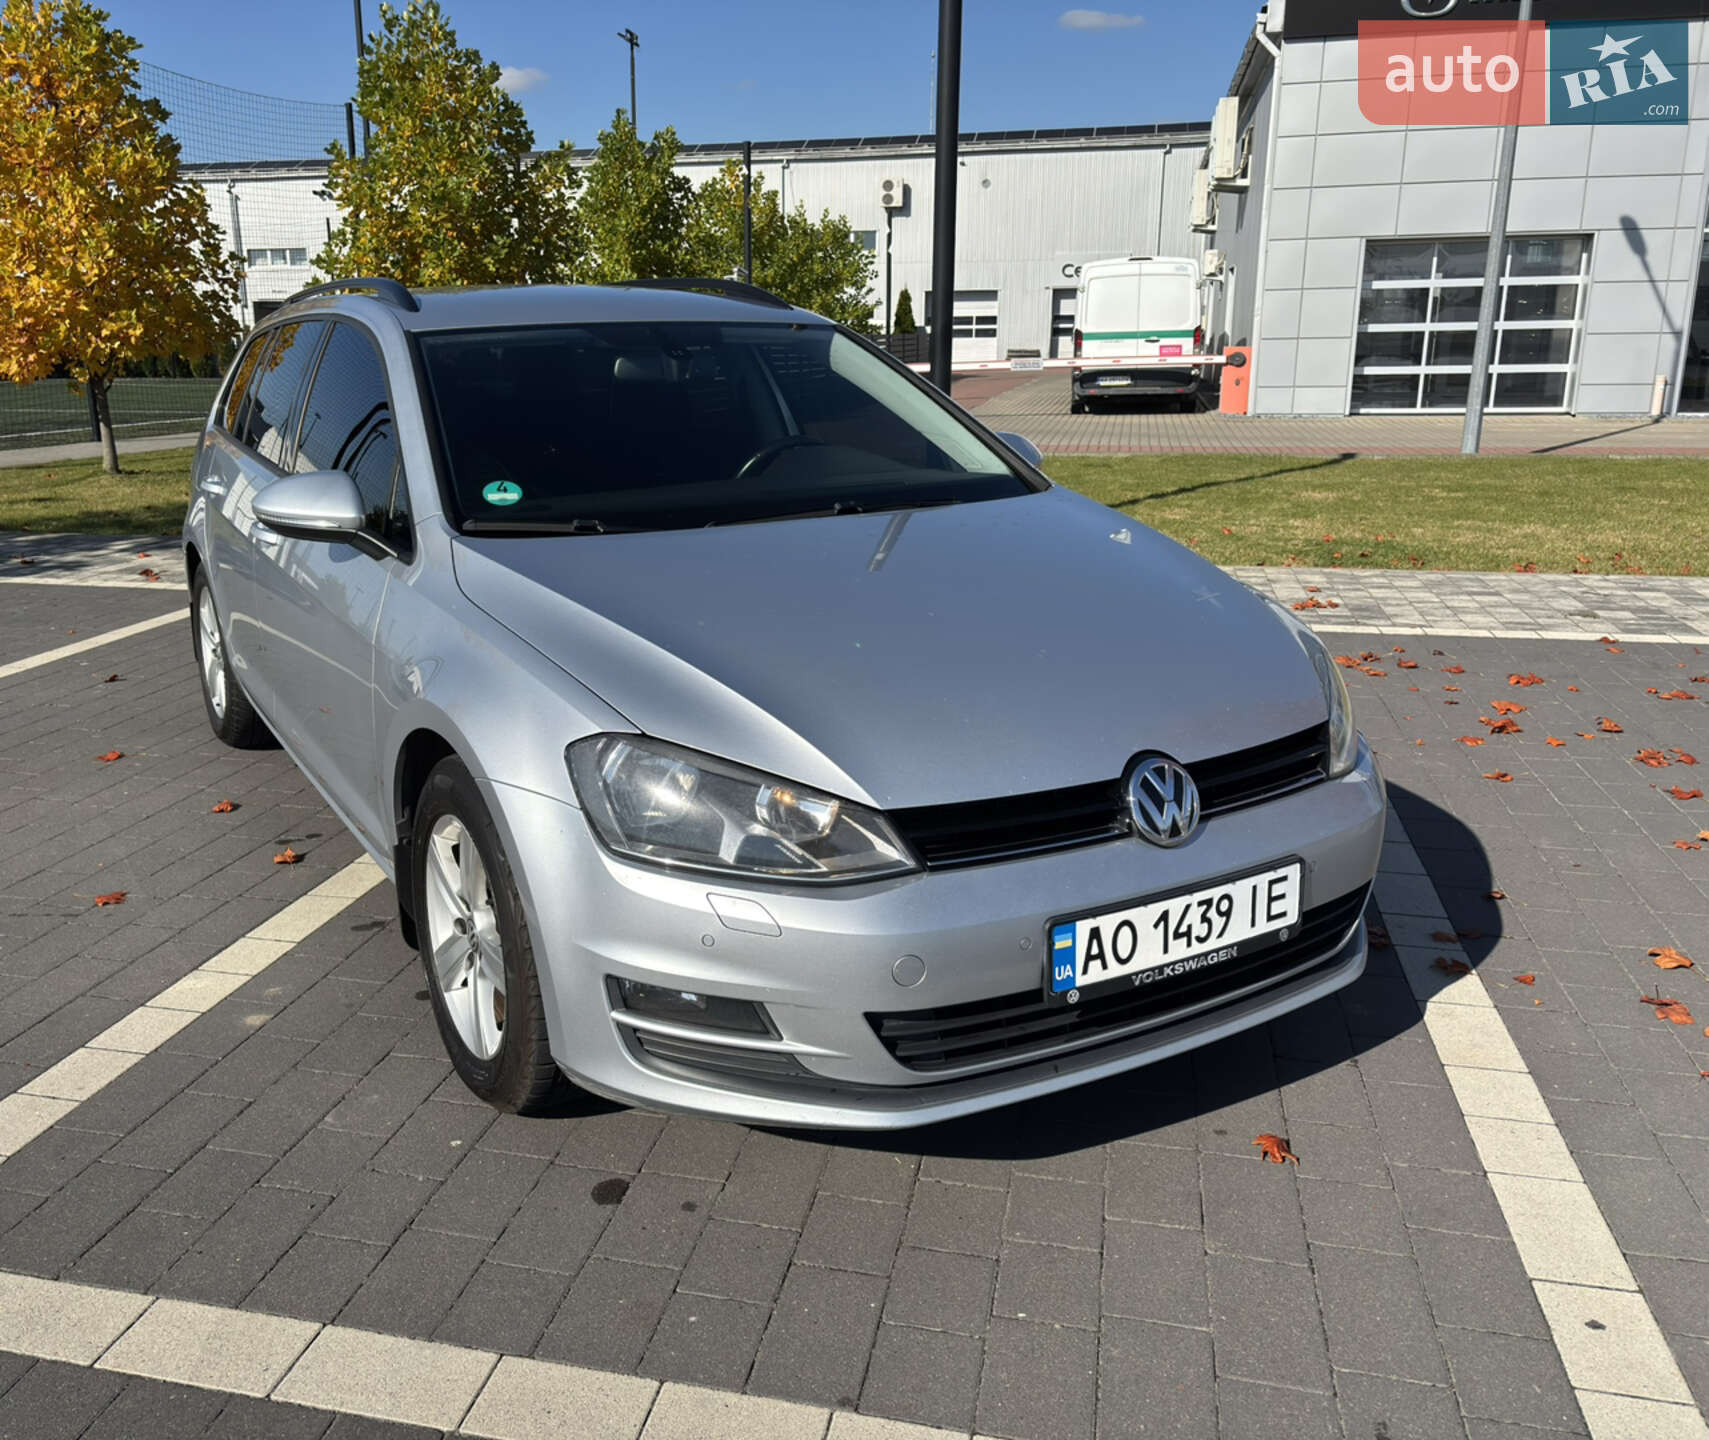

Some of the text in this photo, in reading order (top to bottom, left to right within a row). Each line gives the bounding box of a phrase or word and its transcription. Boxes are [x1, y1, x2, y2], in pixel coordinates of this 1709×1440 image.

[497, 481, 508, 493] 4
[1081, 875, 1289, 976] AO 1439 IE
[1055, 965, 1074, 982] UA
[1131, 946, 1239, 987] VOLKSWAGEN
